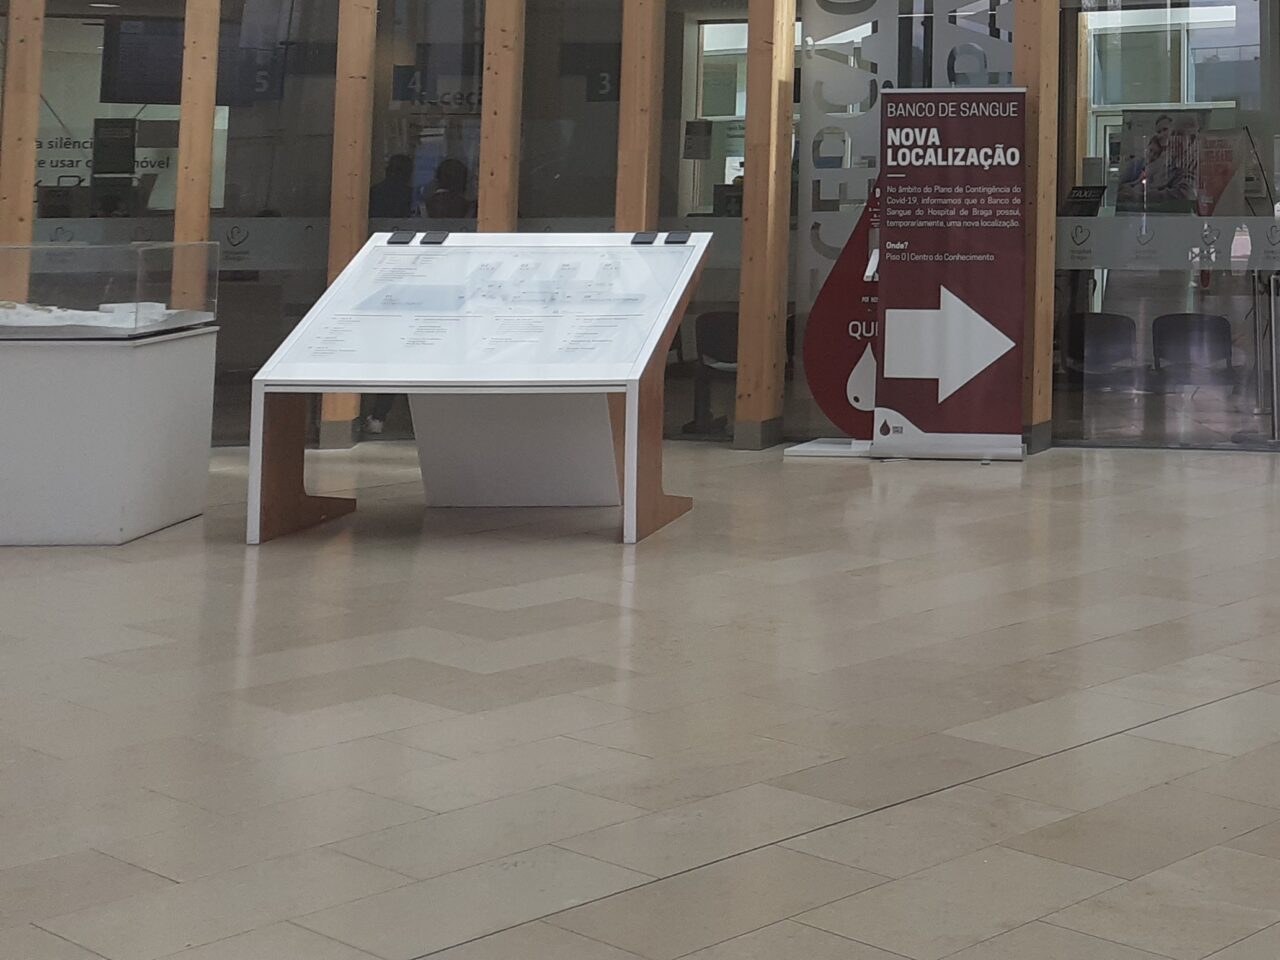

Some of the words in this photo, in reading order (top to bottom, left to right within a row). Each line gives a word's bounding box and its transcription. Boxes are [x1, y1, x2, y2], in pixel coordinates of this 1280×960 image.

[255, 70, 269, 92] 5
[407, 71, 421, 92] 4
[600, 72, 611, 94] 3
[887, 102, 936, 117] BANCO
[939, 102, 957, 117] DE
[960, 102, 1019, 117] SANGUE
[887, 127, 940, 146] NOVA
[50, 159, 82, 168] usar
[887, 144, 1020, 170] LOCALIZAÇÃO
